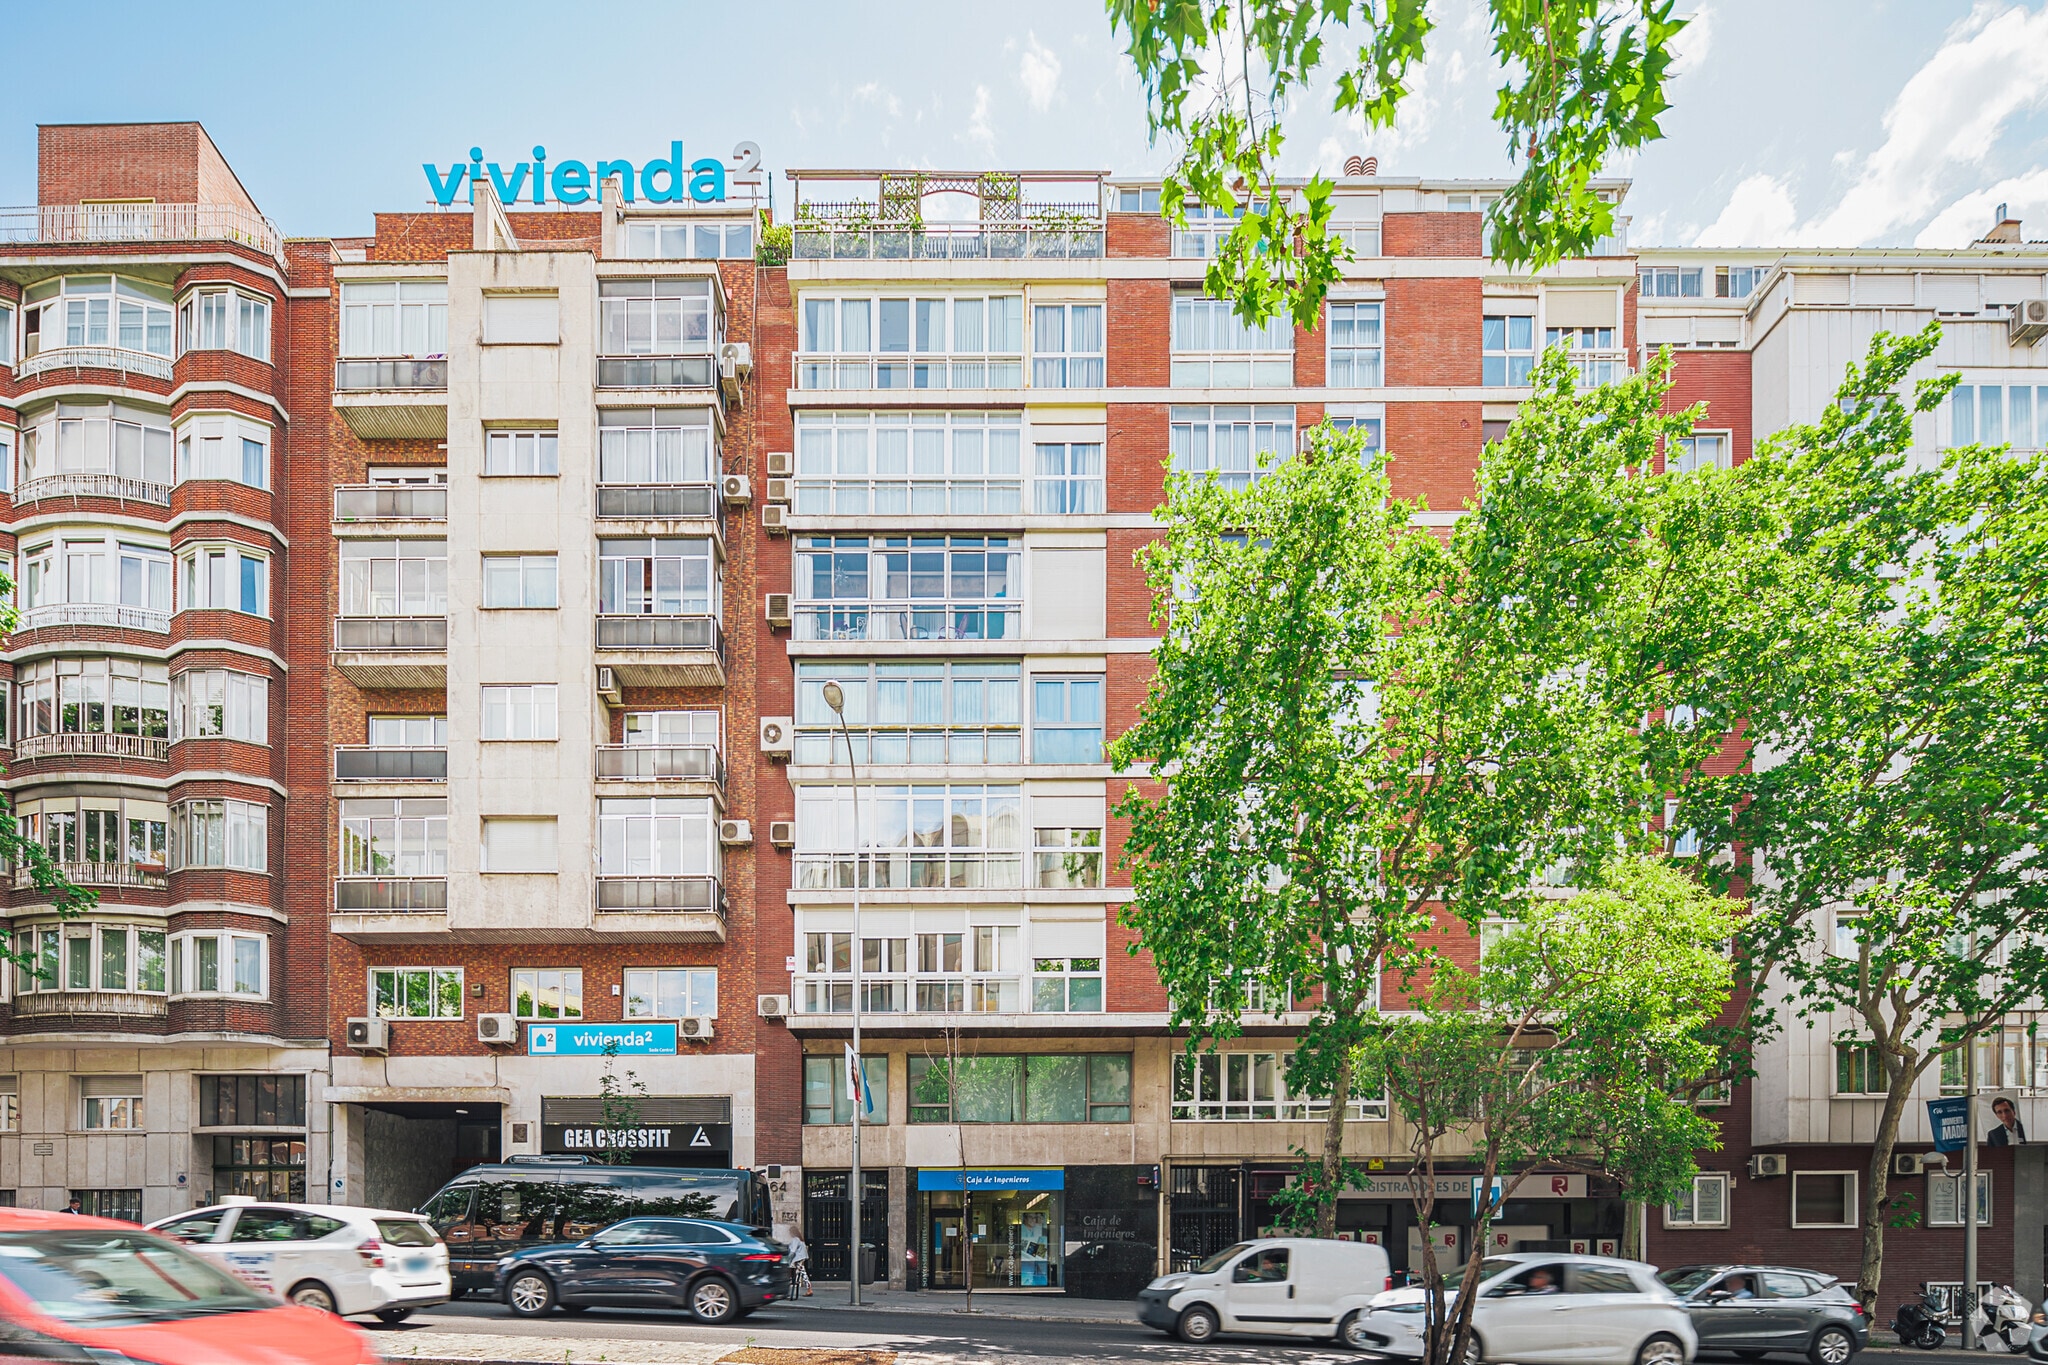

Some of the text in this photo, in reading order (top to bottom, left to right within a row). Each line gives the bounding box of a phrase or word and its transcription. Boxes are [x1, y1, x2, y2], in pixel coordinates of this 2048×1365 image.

[1941, 1116, 1964, 1126] MOMENTO
[1942, 1124, 1968, 1140] MADRI
[564, 1129, 671, 1148] GEA CROSSFIT
[966, 1176, 1030, 1185] Caja de Ingenieros
[1352, 1181, 1468, 1192] GISTRADOES DE
[769, 1181, 787, 1193] 64
[1082, 1215, 1122, 1230] Caja de
[1083, 1229, 1136, 1241] Ingenieros
